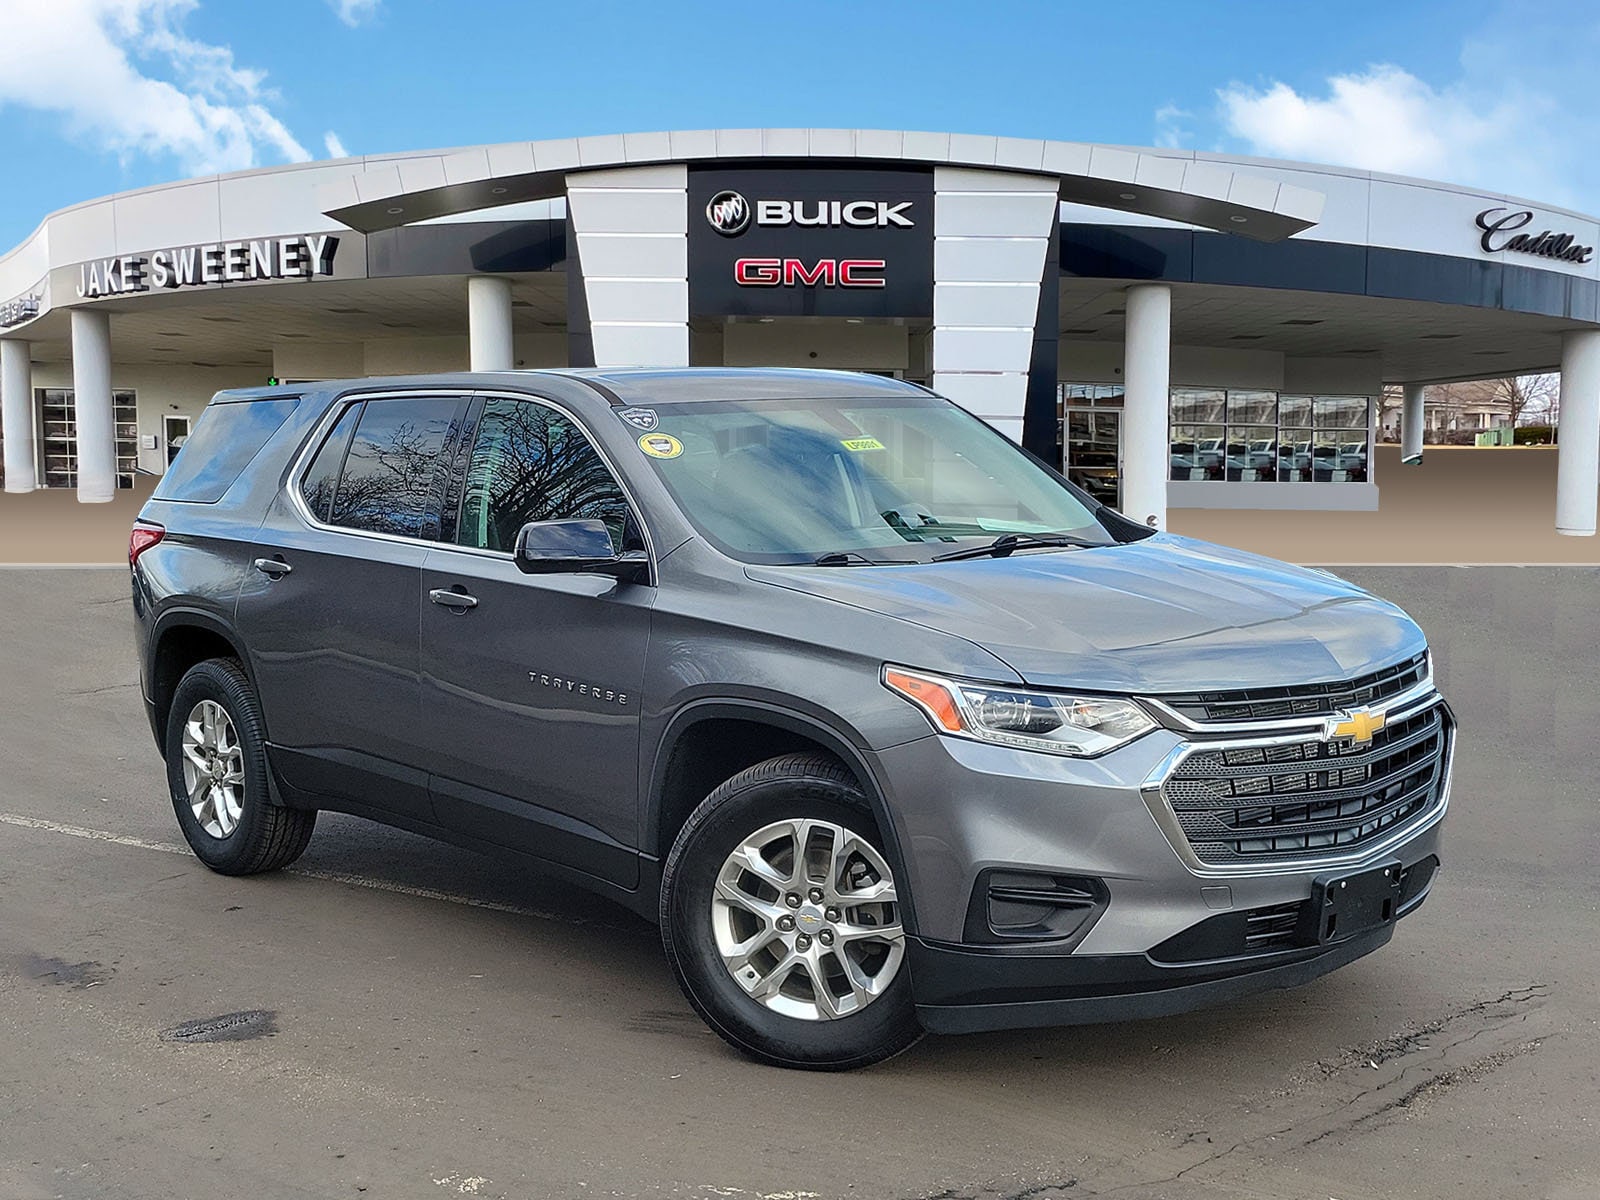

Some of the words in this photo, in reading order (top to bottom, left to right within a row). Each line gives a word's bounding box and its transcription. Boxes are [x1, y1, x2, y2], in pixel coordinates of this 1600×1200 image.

[756, 199, 914, 226] BUICK
[1475, 207, 1593, 263] Cadillac
[76, 255, 147, 298] JAKE
[152, 234, 338, 288] SWEENEY
[734, 257, 887, 287] GMC
[528, 671, 628, 705] TRAVERSE
